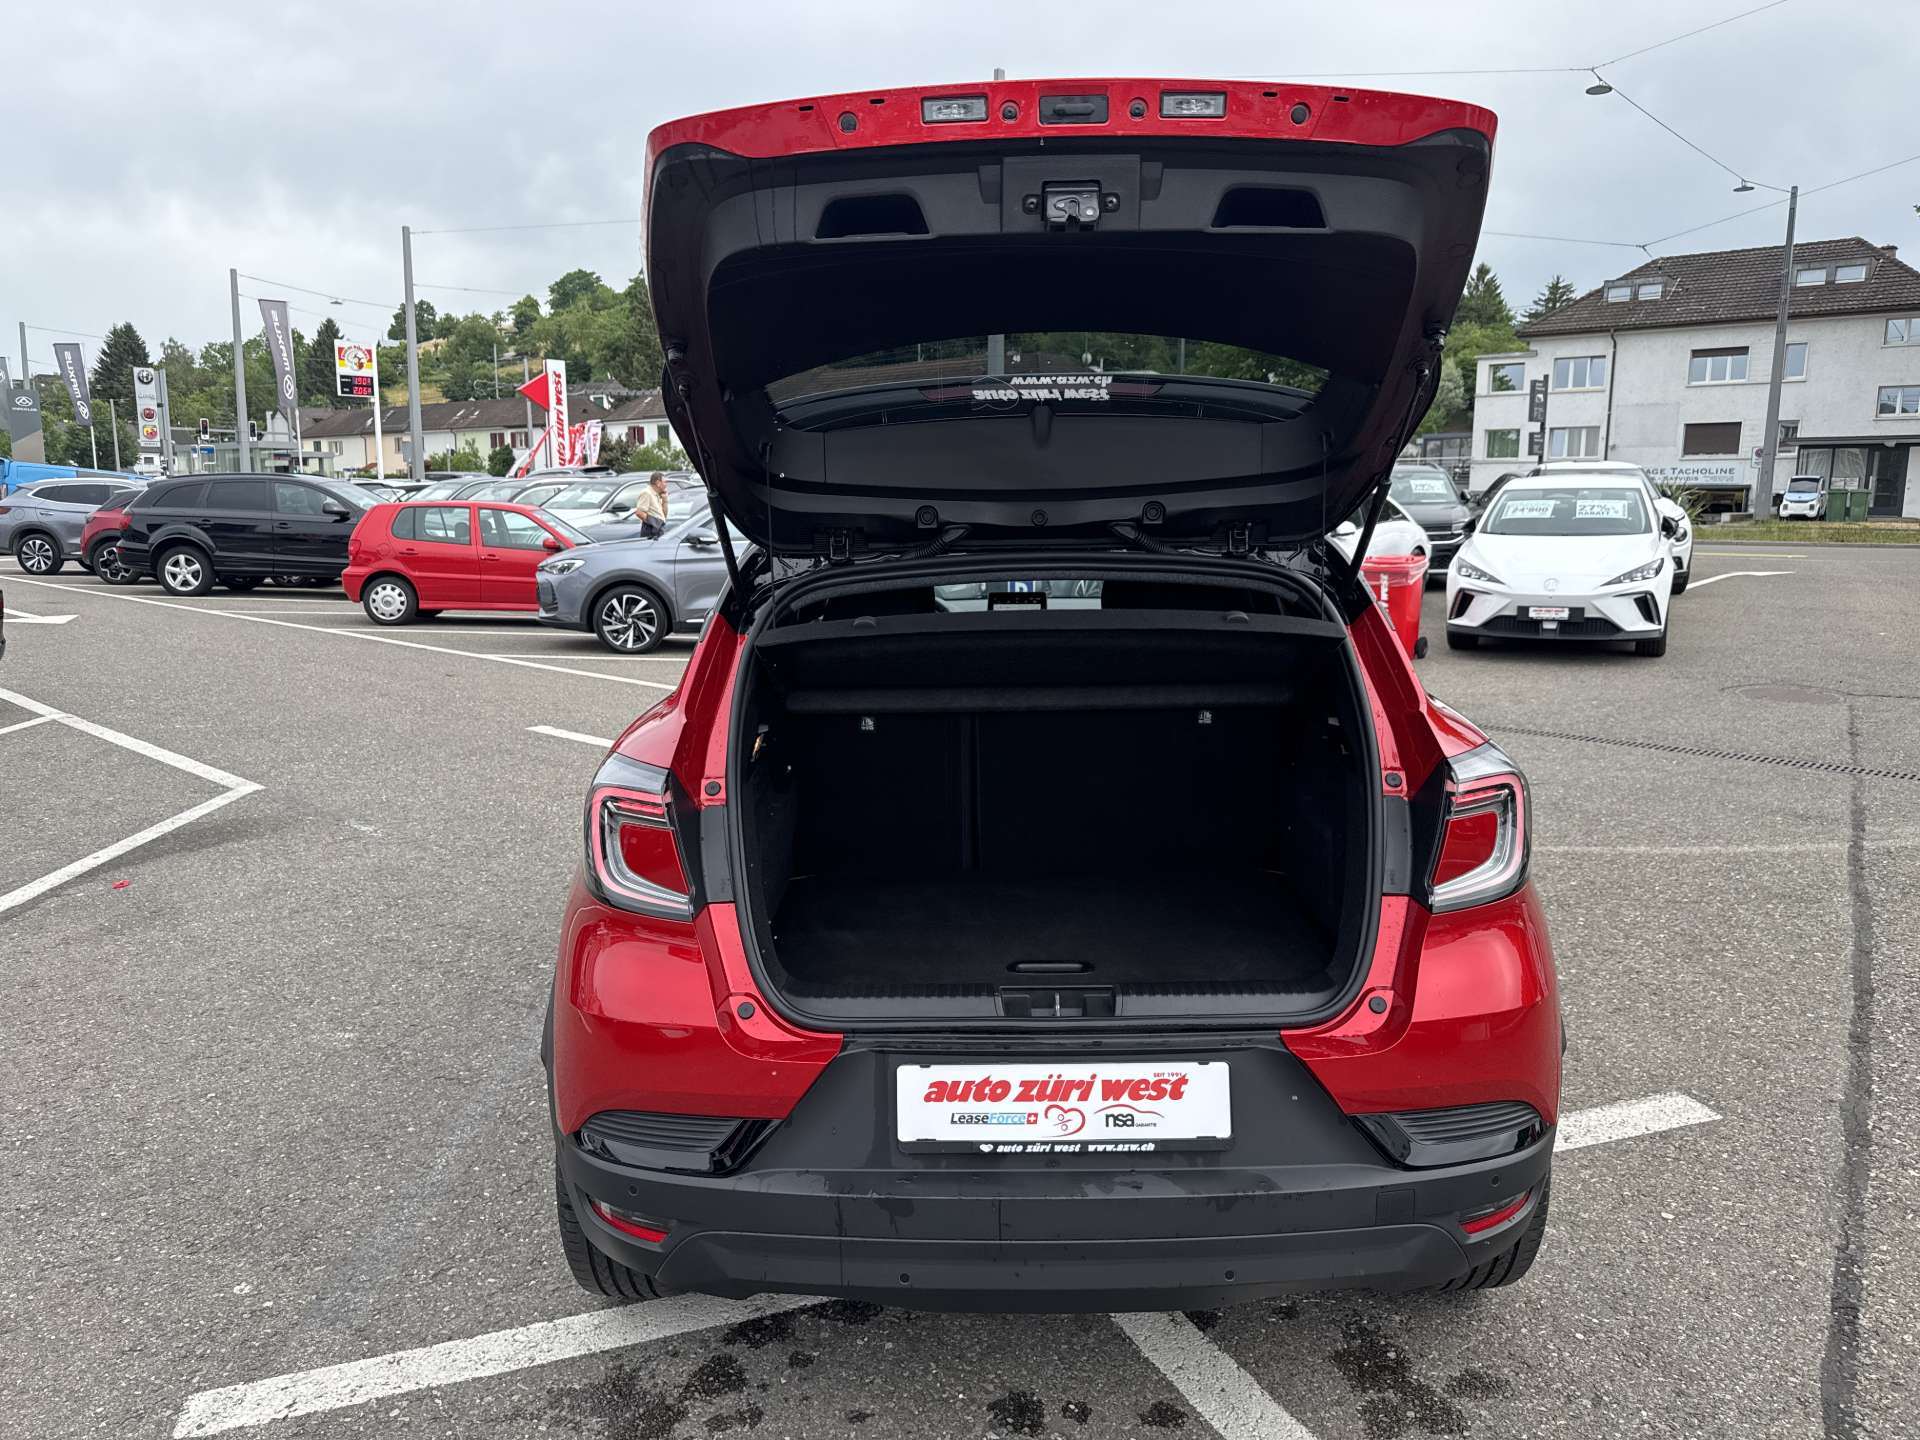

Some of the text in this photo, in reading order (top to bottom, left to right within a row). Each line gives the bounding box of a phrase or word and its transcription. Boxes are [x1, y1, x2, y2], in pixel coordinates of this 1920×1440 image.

[552, 370, 563, 406] west
[557, 442, 567, 467] uto
[1670, 467, 1735, 475] TACHOLINE
[923, 1073, 1189, 1103] auto züri west
[950, 1112, 1027, 1125] LeaseForce
[1105, 1113, 1135, 1128] nsa
[996, 1142, 1156, 1153] auto züri west www.azw.ch
